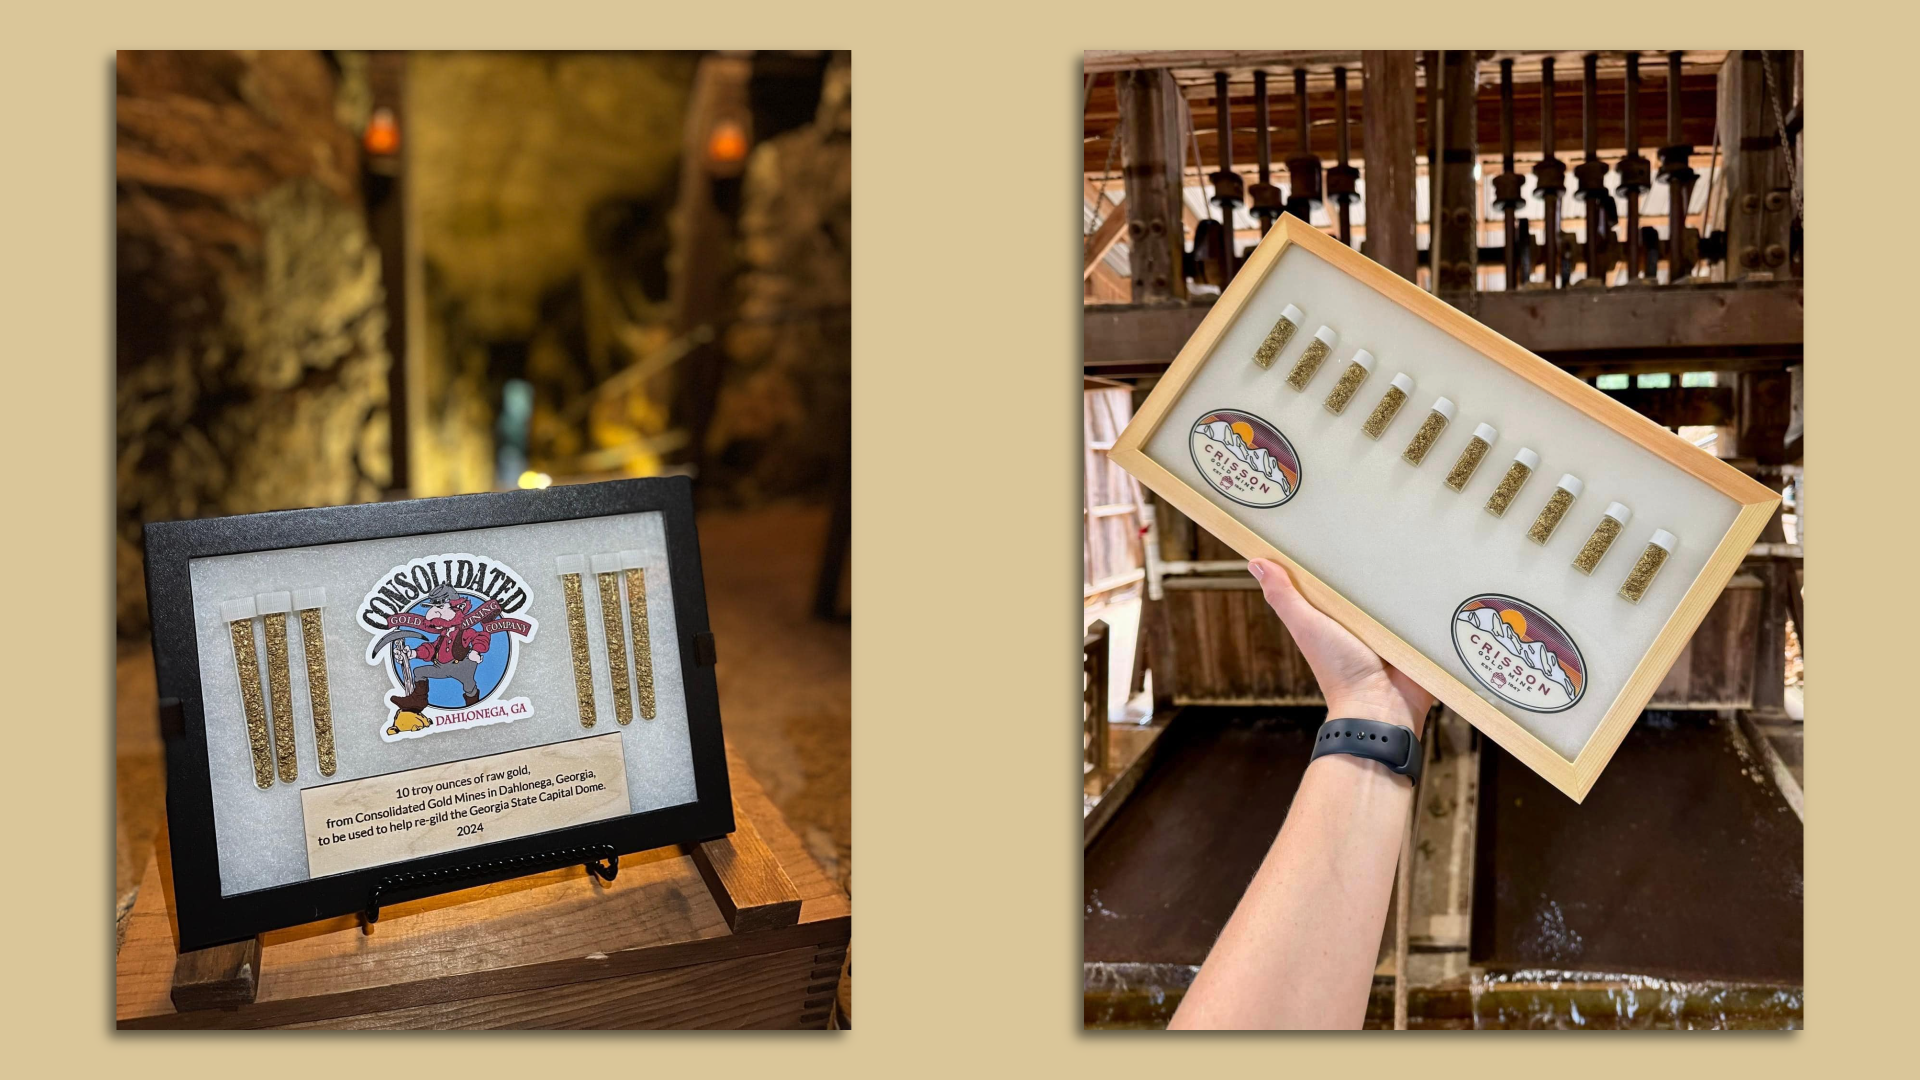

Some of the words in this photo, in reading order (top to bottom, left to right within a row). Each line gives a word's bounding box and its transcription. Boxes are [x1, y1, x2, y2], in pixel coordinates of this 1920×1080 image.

[1204, 444, 1270, 494] CRISSON
[1211, 458, 1231, 474] GOLD
[1235, 475, 1255, 491] MINE
[362, 559, 527, 630] CONSOLIDATED
[390, 616, 422, 627] GOLD
[461, 601, 498, 629] MINING
[485, 621, 529, 633] COMPANY
[1470, 634, 1551, 696] CRISSON
[1478, 650, 1503, 670] GOLD
[1508, 672, 1532, 692] MINE
[435, 706, 509, 726] DAHLONEGA,
[510, 702, 527, 714] GA
[326, 817, 354, 829] from
[355, 801, 426, 823] Consolidated
[427, 795, 453, 809] Gold
[455, 791, 486, 805] Mines
[488, 787, 497, 798] in
[500, 778, 554, 796] Dahlonega,
[556, 769, 596, 785] Georgia,
[396, 787, 410, 799] 10
[412, 784, 433, 796] troy
[435, 777, 472, 791] ounces
[474, 773, 485, 784] of
[486, 771, 505, 781] raw
[507, 765, 531, 780] gold,
[318, 836, 330, 846] to
[332, 832, 346, 844] be
[348, 826, 374, 840] used
[375, 824, 388, 835] to
[390, 819, 413, 832] help
[414, 811, 449, 827] re-gild
[450, 808, 468, 820] the
[469, 799, 509, 816] Georgia
[511, 795, 537, 808] State
[538, 788, 573, 802] Capital
[575, 782, 606, 795] Dome.
[456, 822, 484, 837] 2024
